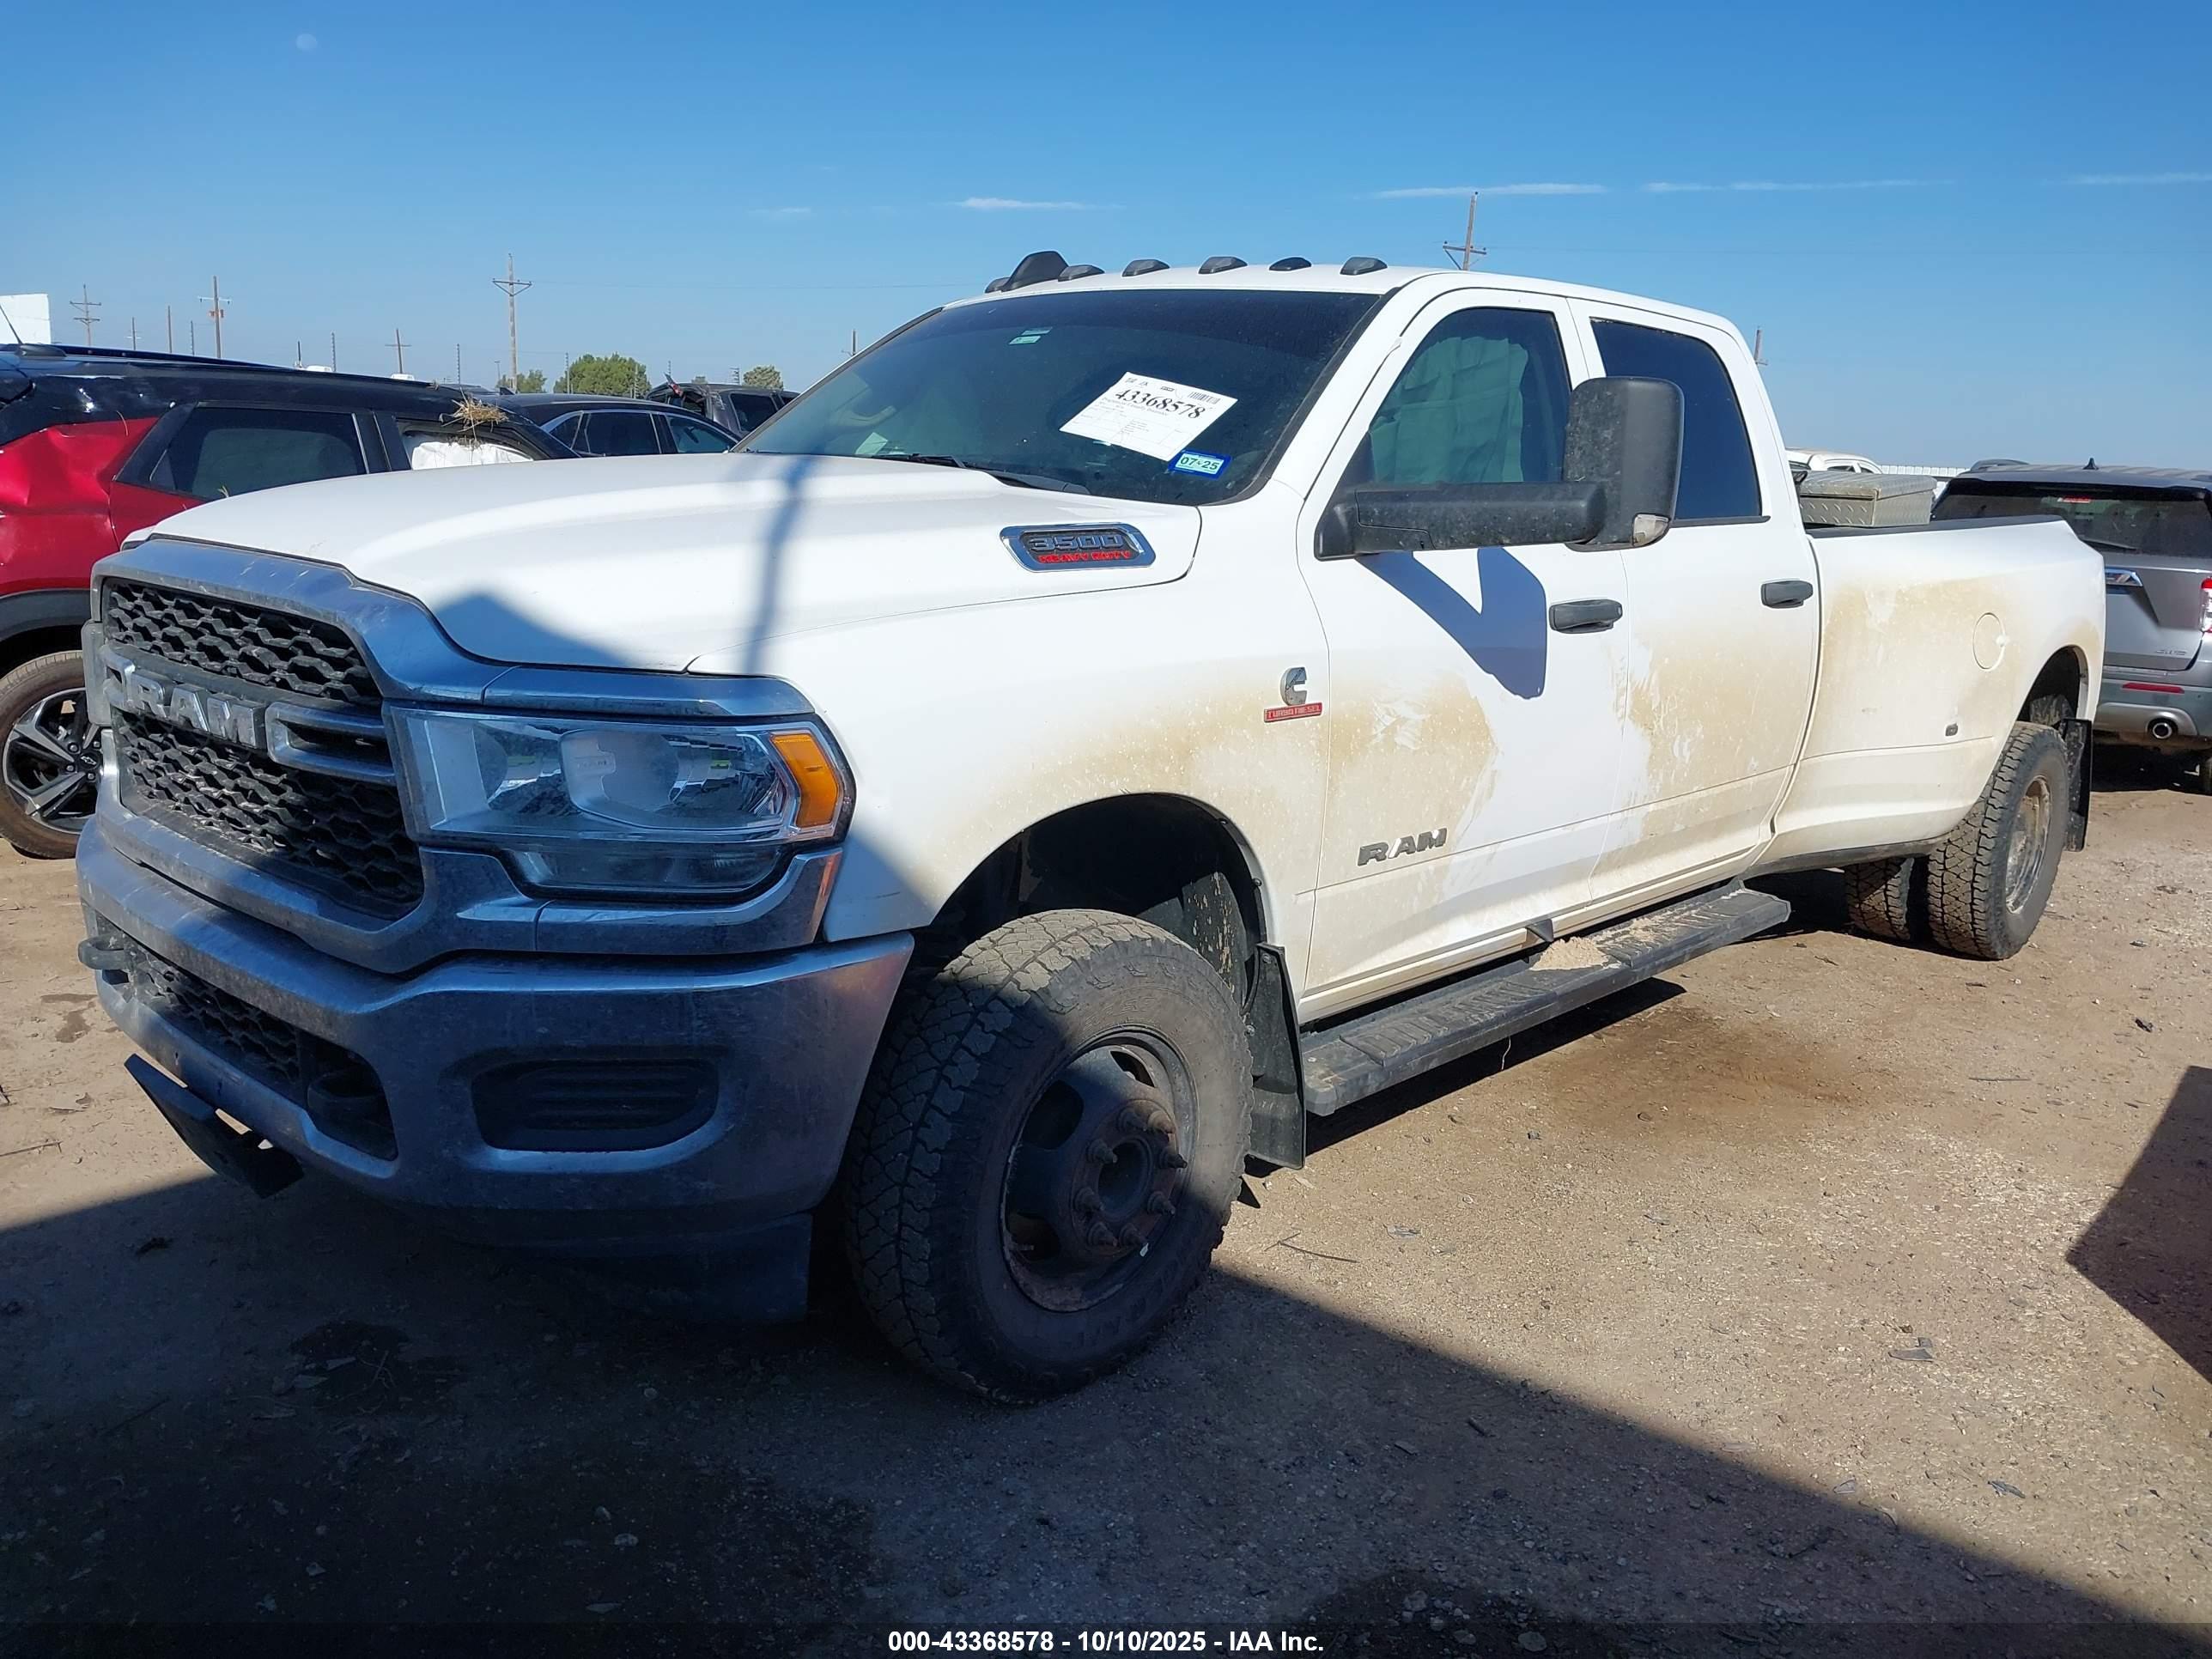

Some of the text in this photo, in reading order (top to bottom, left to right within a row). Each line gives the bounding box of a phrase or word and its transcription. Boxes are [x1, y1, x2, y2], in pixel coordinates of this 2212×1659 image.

[1115, 389, 1206, 419] 43368578
[1180, 457, 1197, 465] 07
[1201, 460, 1219, 471] 25
[1030, 534, 1125, 552] 3500
[127, 668, 259, 750] RAM
[1357, 828, 1448, 866] RAM
